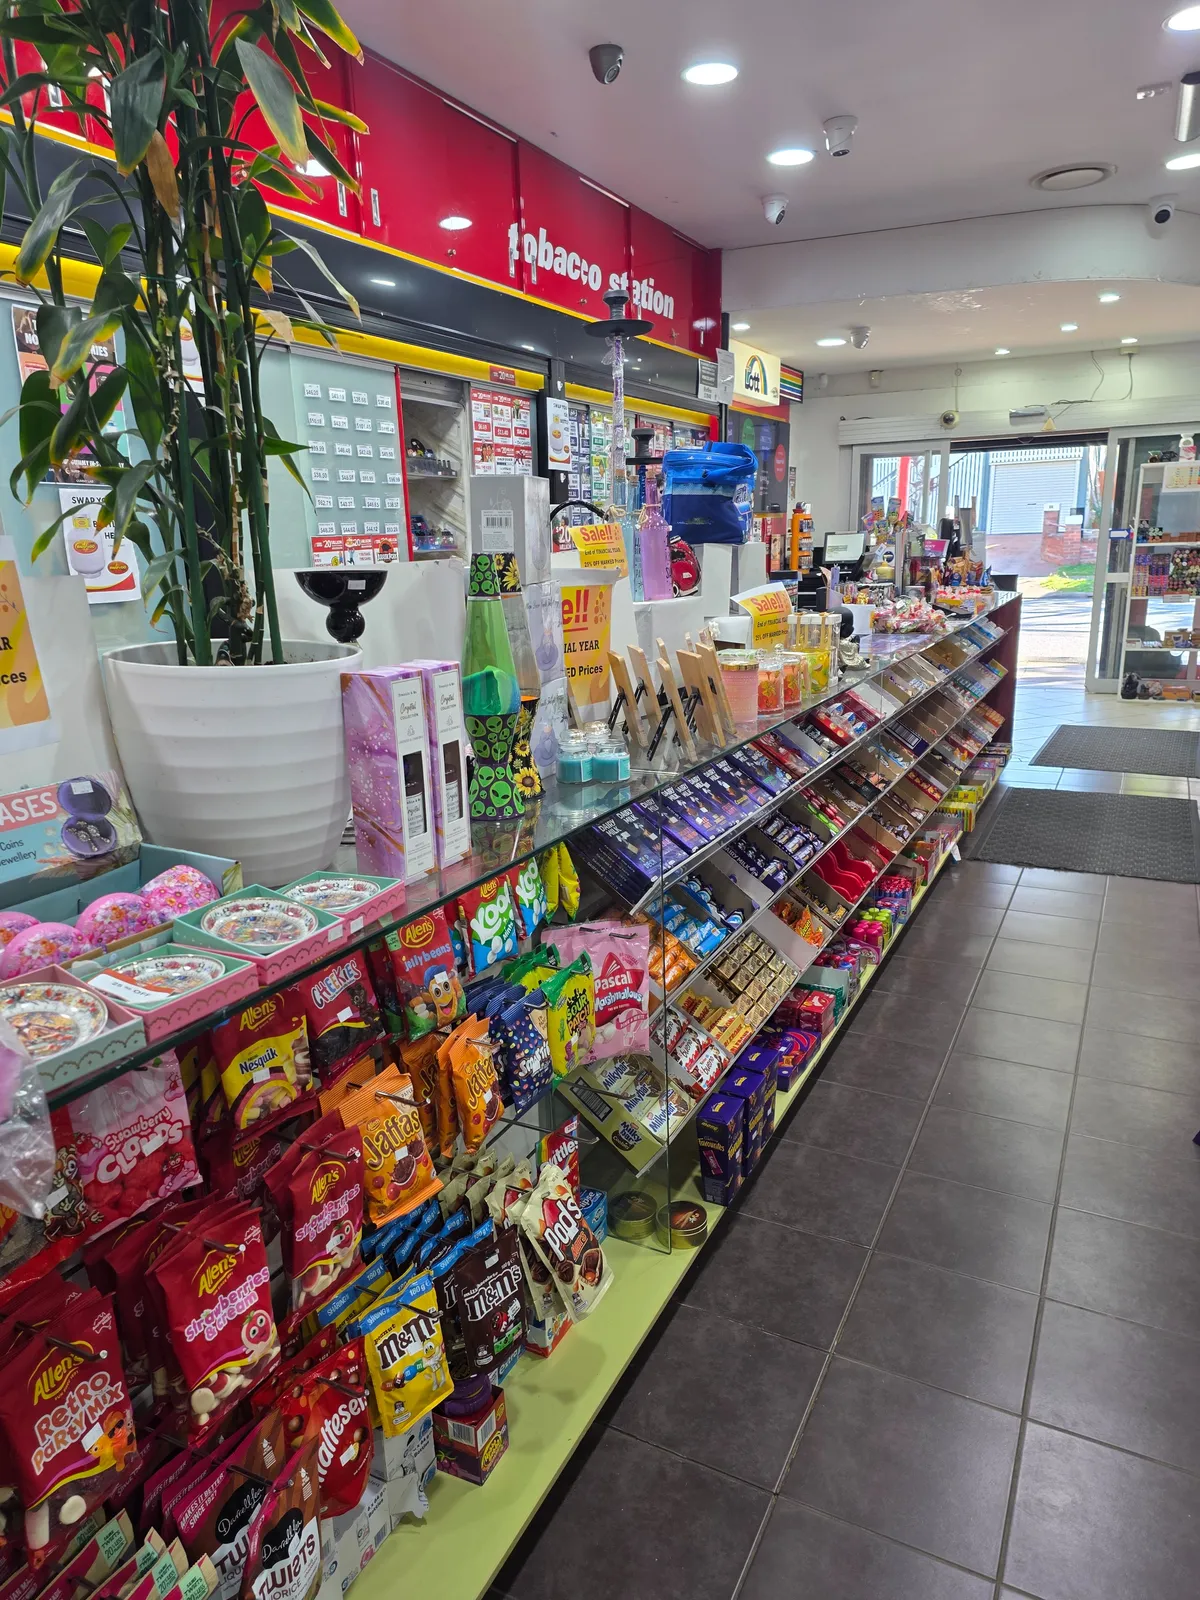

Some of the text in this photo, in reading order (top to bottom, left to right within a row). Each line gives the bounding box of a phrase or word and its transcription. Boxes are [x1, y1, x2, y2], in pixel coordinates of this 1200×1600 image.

[508, 222, 675, 320] tobacco station
[580, 525, 613, 542] Sale!!
[752, 591, 784, 613] Sale!!
[579, 639, 600, 651] YEAR
[578, 663, 603, 677] Prices
[616, 808, 633, 819] DAIRY
[623, 815, 639, 824] MILK
[0, 839, 24, 852] Coins
[405, 920, 433, 944] Allen's
[502, 921, 514, 940] Mints
[311, 959, 362, 1009] CHEEKIES
[594, 970, 633, 993] Pascal
[239, 1000, 276, 1032] Allen's
[566, 993, 588, 1019] SOUR
[567, 1007, 591, 1036] PATCH
[239, 1047, 278, 1074] Nesquik
[602, 1060, 629, 1090] Milkybar
[623, 1083, 651, 1112] Milkybar
[104, 1105, 173, 1150] Strawberry
[362, 1110, 421, 1171] Jaffas
[311, 1168, 340, 1205] Allen's
[543, 1195, 582, 1262] Pods
[197, 1254, 238, 1298] Allen's
[184, 1266, 270, 1342] strawberries
[408, 1286, 420, 1297] 180
[204, 1290, 259, 1342] & cream
[373, 1323, 397, 1345] peanut
[33, 1353, 85, 1406] Allen's
[318, 1394, 368, 1489] alteser
[180, 1471, 225, 1530] MAKES IT BETTER
[189, 1505, 206, 1528] SINCE
